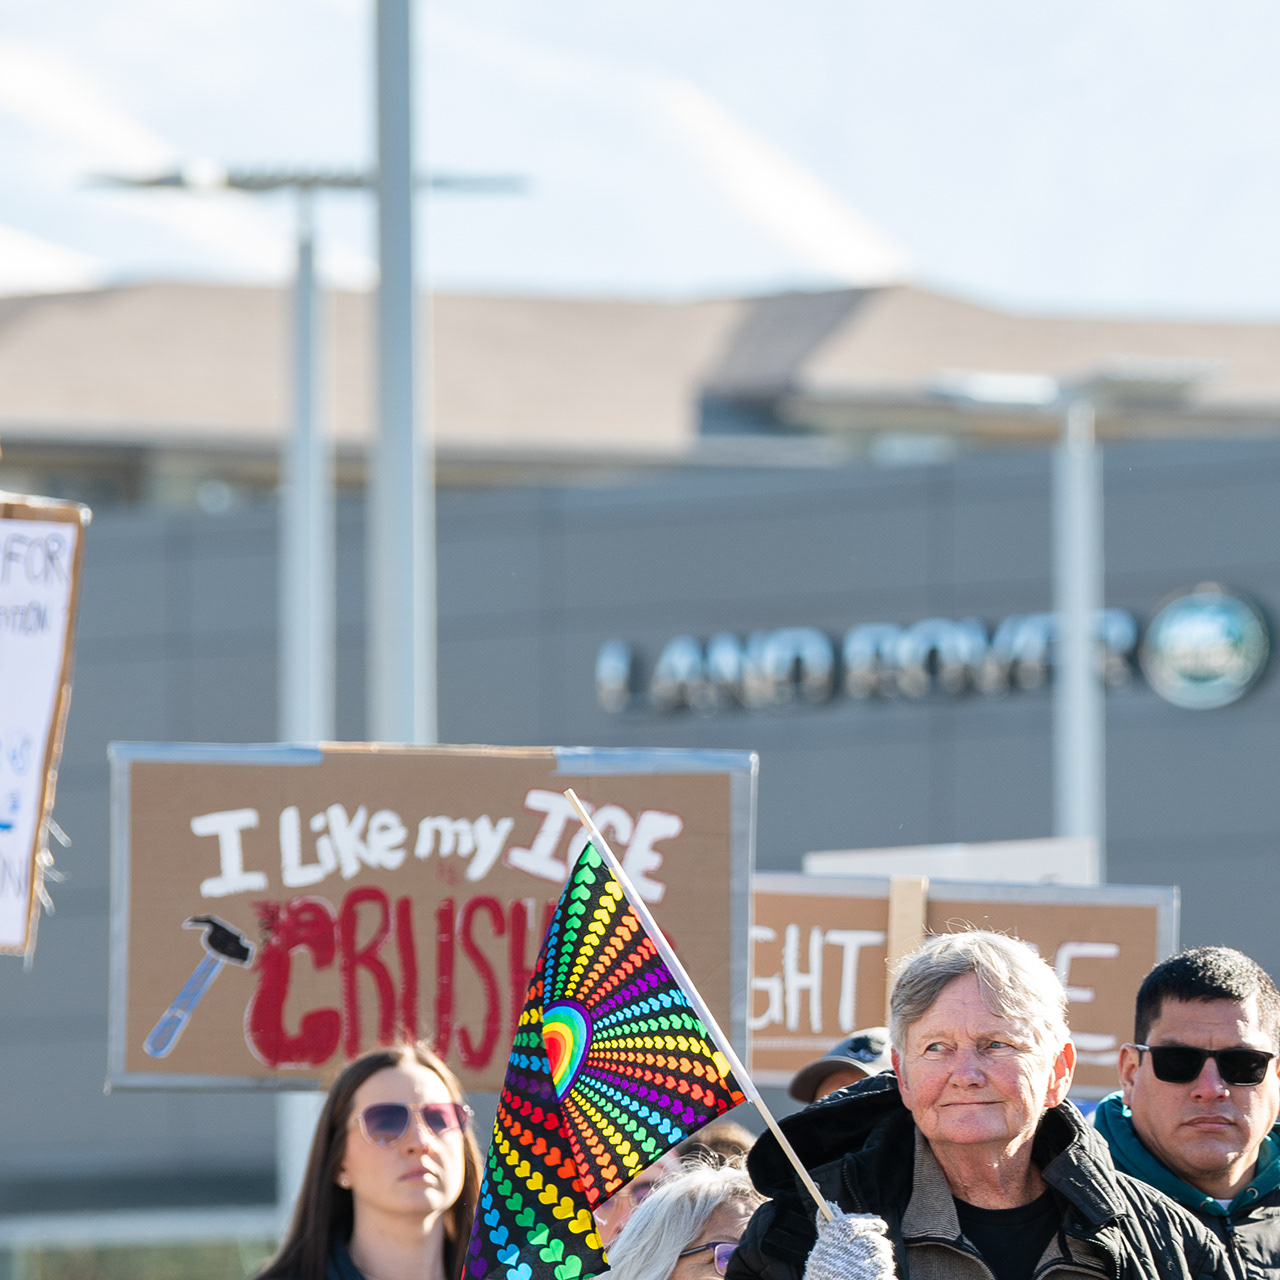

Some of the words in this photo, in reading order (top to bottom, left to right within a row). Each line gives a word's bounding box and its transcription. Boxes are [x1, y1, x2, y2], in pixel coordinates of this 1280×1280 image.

[2, 532, 69, 586] FOR
[190, 808, 269, 898] I
[279, 802, 408, 889] Like
[414, 813, 515, 882] my
[244, 885, 676, 1071] CRUSH
[750, 923, 887, 1034] GHT
